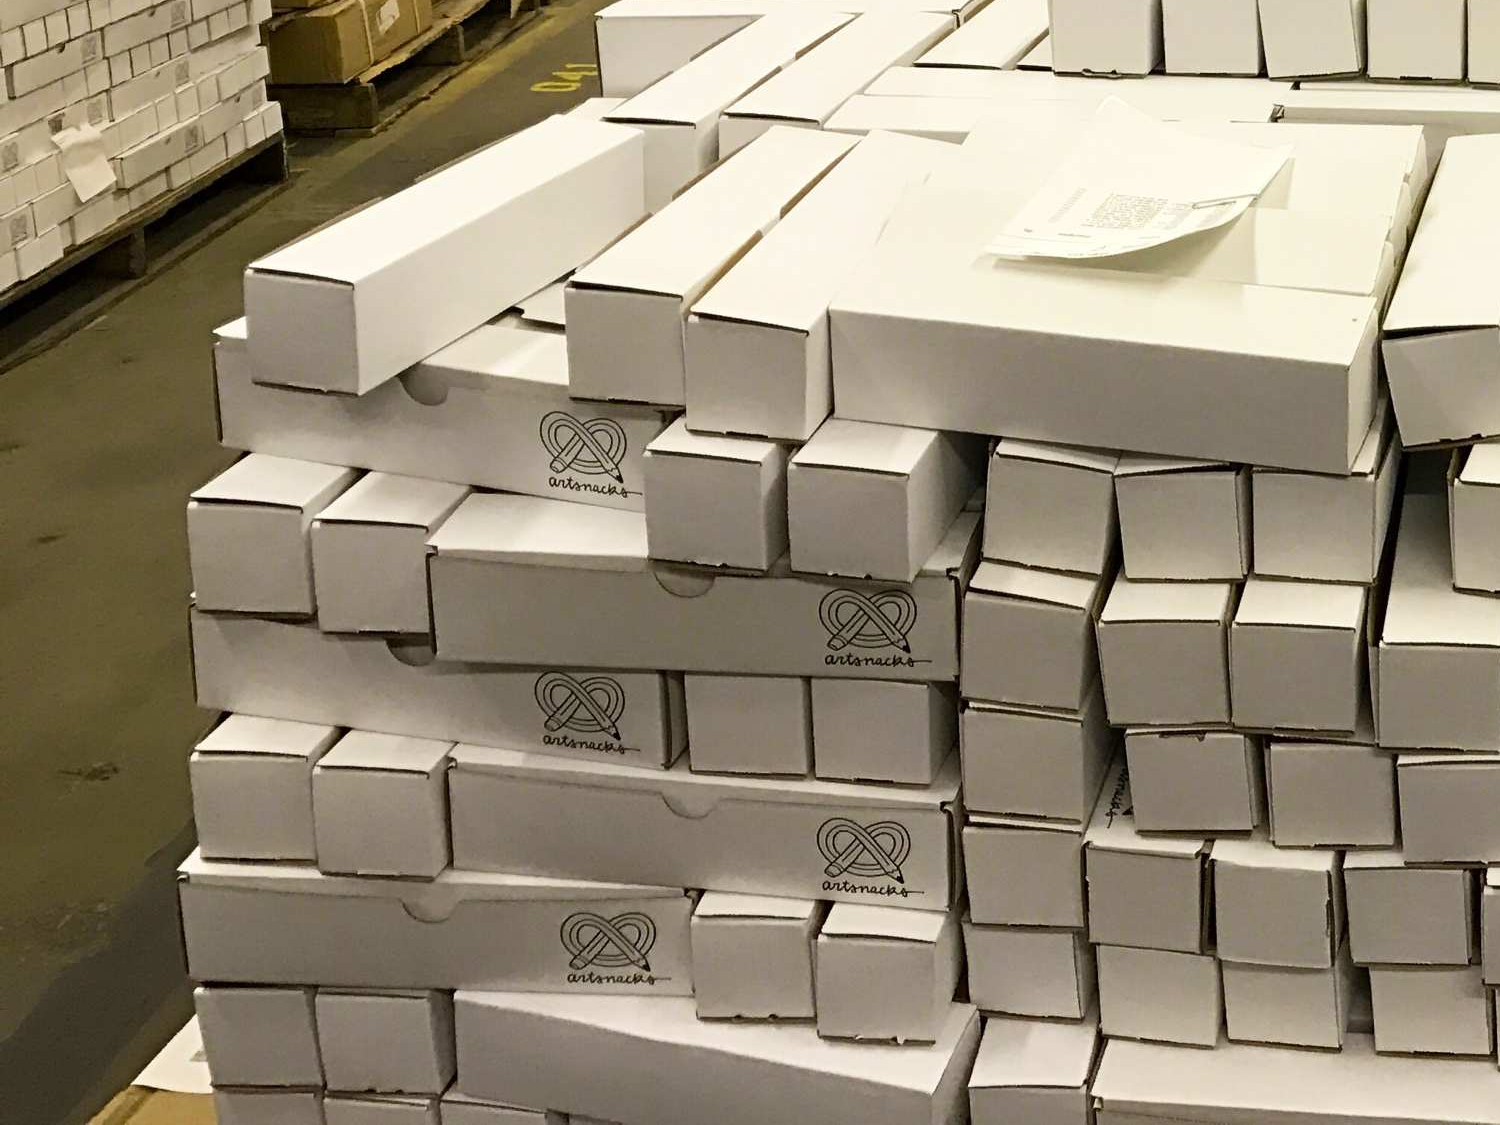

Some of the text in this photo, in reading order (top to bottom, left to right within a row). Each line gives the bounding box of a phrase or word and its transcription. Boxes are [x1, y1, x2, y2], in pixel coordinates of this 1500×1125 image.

[548, 476, 643, 498] artsnacks
[825, 653, 932, 668] artsnacks
[543, 734, 641, 755] artsnacks
[822, 880, 925, 898] artsnacks
[567, 971, 672, 985] artsnacks
